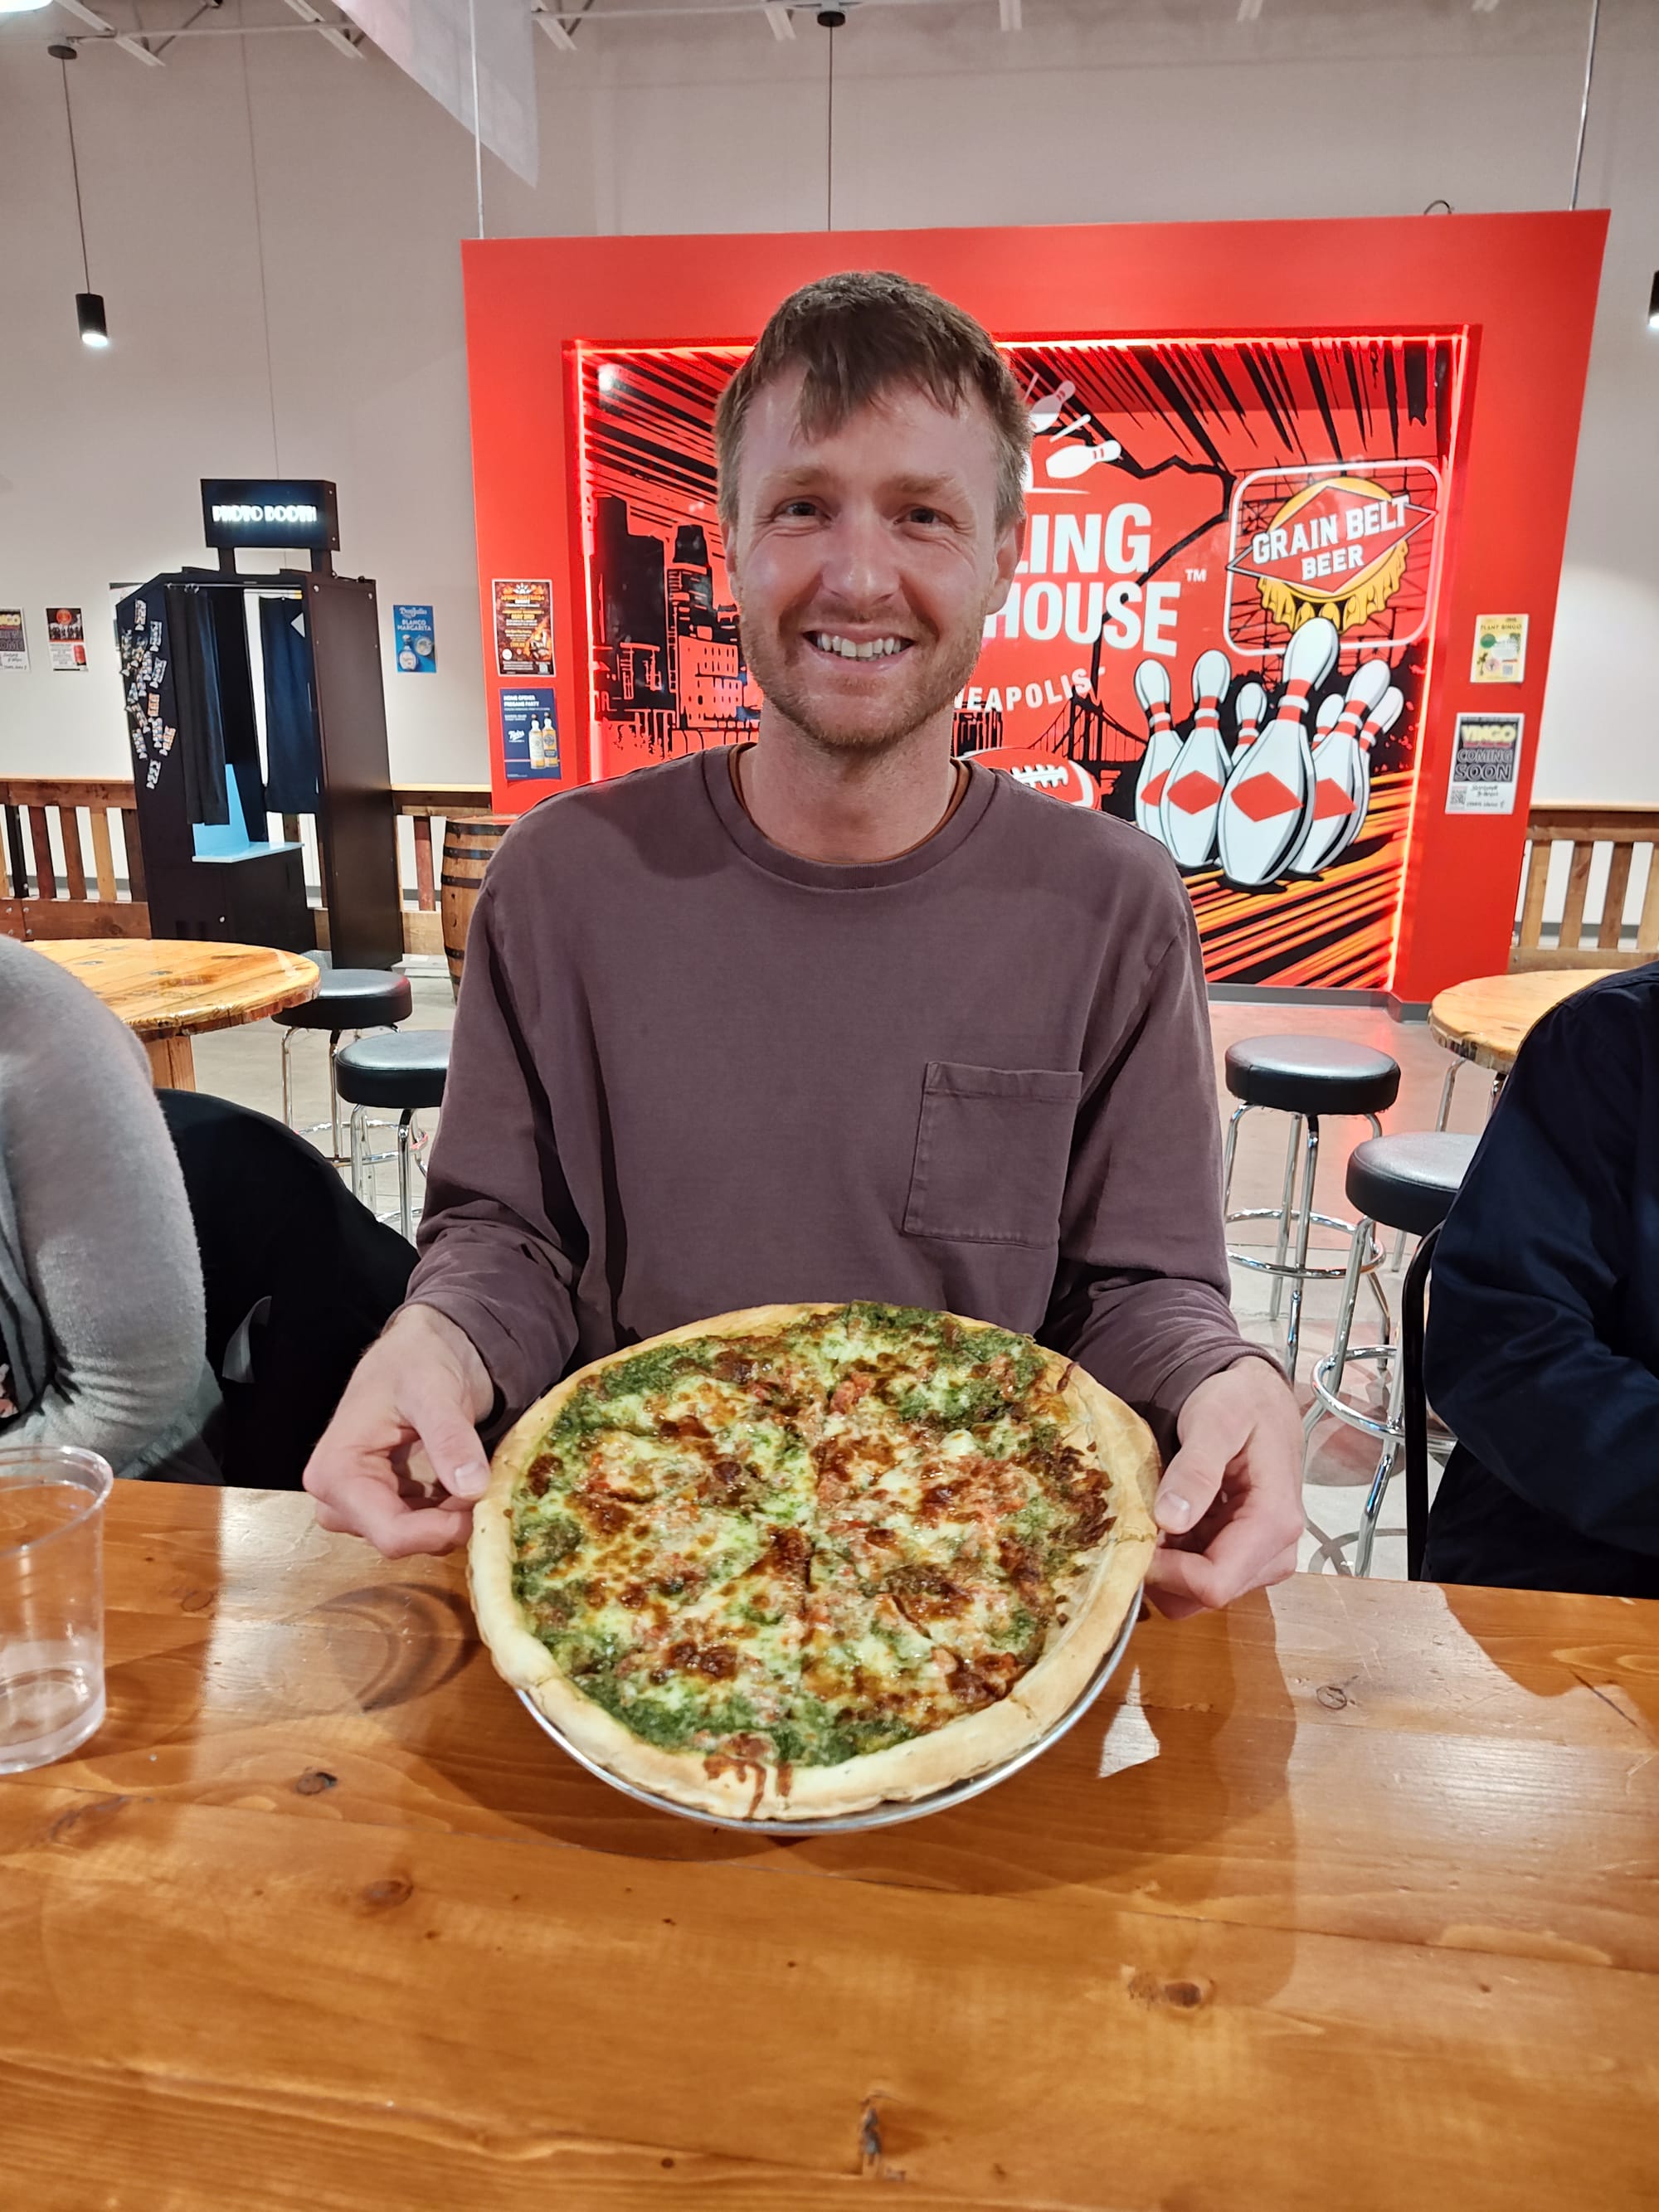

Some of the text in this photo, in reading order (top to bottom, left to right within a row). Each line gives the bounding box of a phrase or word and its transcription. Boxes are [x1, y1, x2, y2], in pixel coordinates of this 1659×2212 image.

[212, 504, 263, 522] PHOTO
[1014, 503, 1151, 574] ING
[1252, 494, 1410, 565] GRAIN BELT
[1301, 544, 1365, 581] BEER
[982, 581, 1181, 657] HOUSE
[1461, 723, 1516, 743] VINGO
[1457, 749, 1514, 763] COMING
[1454, 764, 1512, 780] SOON
